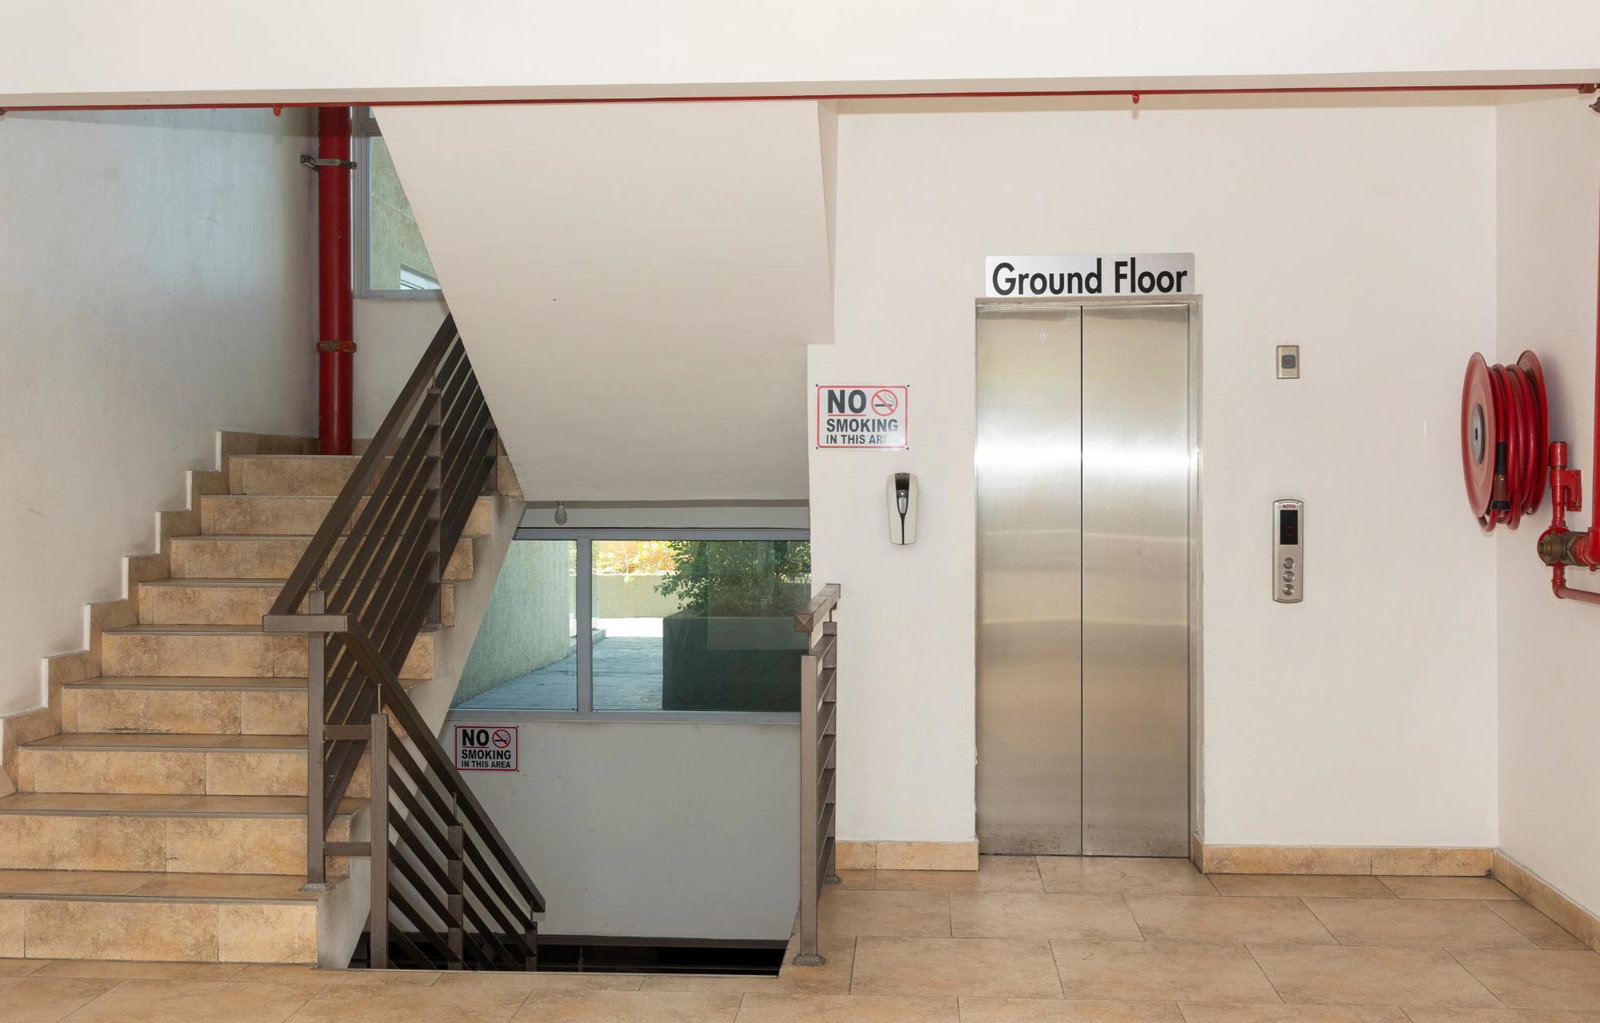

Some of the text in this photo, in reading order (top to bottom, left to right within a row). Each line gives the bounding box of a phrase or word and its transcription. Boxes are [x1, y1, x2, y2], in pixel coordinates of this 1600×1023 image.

[992, 257, 1188, 295] Ground Floor
[827, 389, 867, 414] NO
[826, 418, 898, 433] SMOKING
[826, 434, 895, 445] IN THIS AR
[462, 729, 489, 746] NO
[461, 749, 511, 760] SMOKING
[491, 761, 511, 769] AREA
